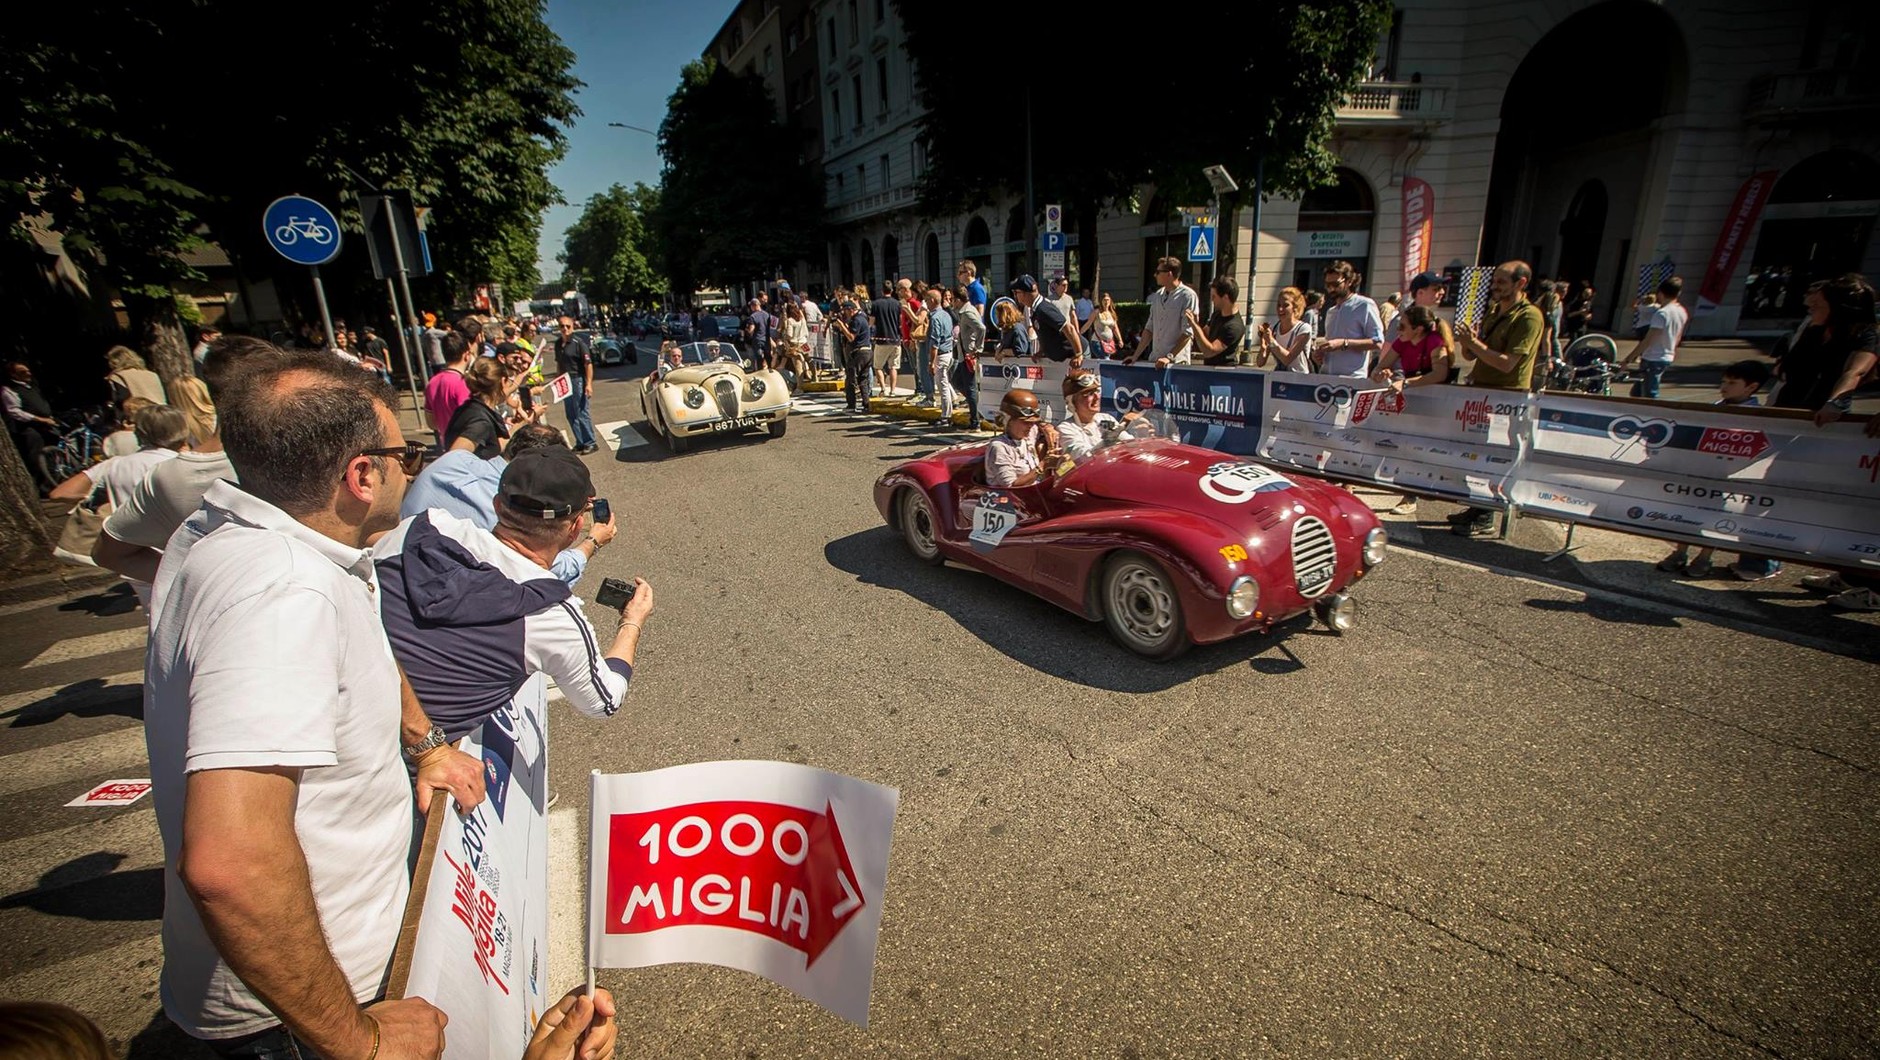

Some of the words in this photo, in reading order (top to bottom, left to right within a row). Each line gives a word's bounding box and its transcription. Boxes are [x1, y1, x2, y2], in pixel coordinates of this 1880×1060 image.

[1049, 235, 1059, 250] P
[1163, 390, 1196, 411] MILLE
[1201, 394, 1245, 416] MIGLIA
[1464, 394, 1493, 414] Mille
[1494, 403, 1528, 416] 2017
[735, 417, 755, 428] YUR
[1703, 441, 1752, 455] MIGLIA
[1712, 430, 1755, 443] 1000
[1230, 466, 1271, 481] 150
[1662, 482, 1775, 508] CHOPARD
[982, 511, 1005, 534] 150
[1218, 544, 1249, 563] 150
[109, 784, 149, 792] 1000
[461, 806, 488, 872] 2017
[638, 813, 810, 867] 1000
[444, 850, 478, 936] Mille
[620, 873, 811, 940] MIGLIA
[494, 910, 508, 948] 18-21
[473, 889, 509, 995] Miglia
